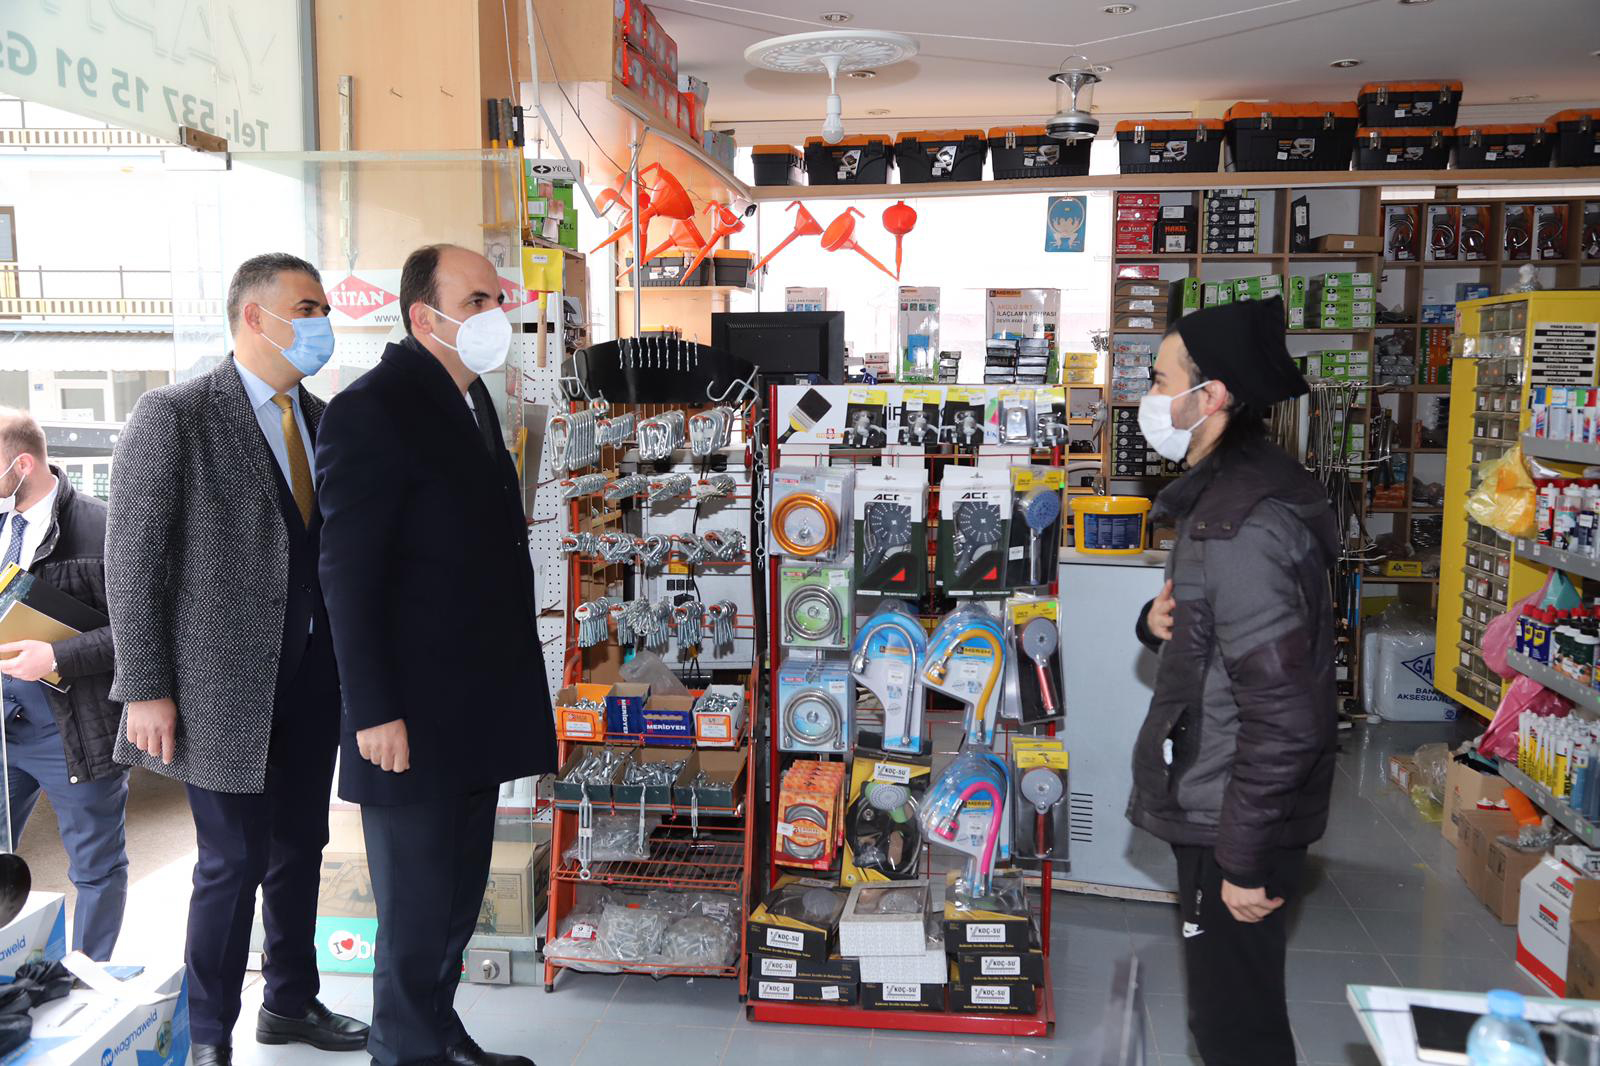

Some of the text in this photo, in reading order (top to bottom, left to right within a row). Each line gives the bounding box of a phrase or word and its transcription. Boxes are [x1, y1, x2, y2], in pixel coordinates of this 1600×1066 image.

[330, 283, 385, 307] KİTAN
[1415, 688, 1435, 697] BAN
[621, 699, 629, 735] MERİDYE
